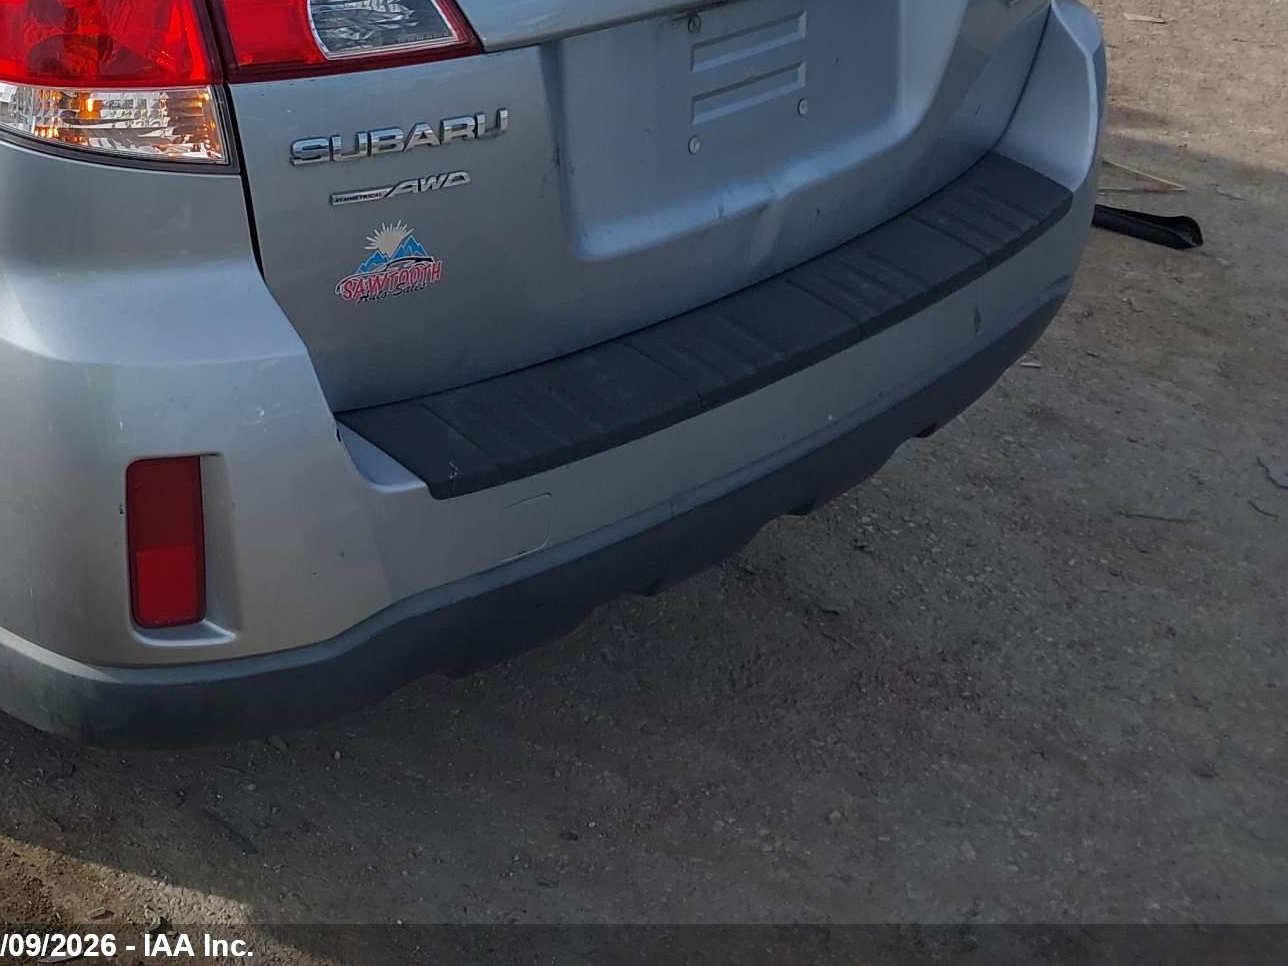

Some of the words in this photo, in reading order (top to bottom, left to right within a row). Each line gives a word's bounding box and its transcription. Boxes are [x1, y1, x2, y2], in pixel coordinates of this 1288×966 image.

[290, 107, 509, 166] SUBARU
[385, 170, 471, 197] AWD
[343, 260, 442, 301] SAWTOOTH
